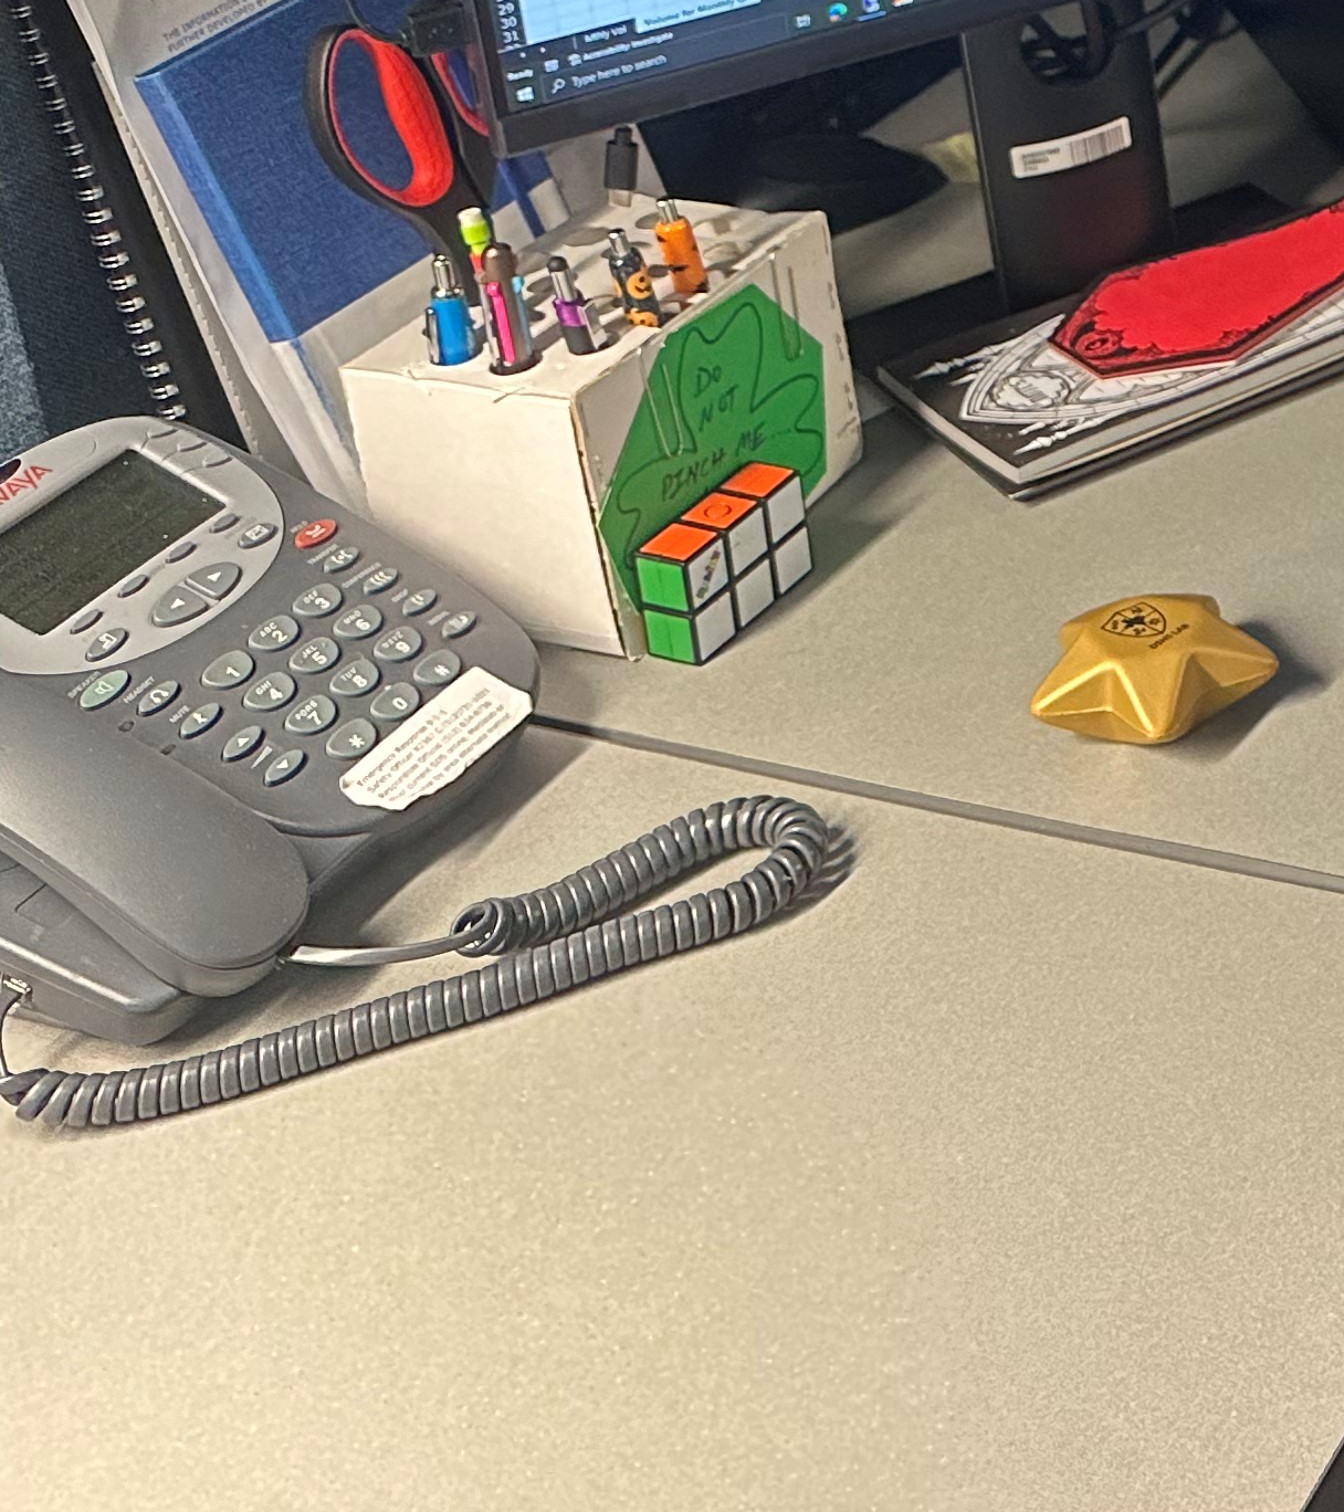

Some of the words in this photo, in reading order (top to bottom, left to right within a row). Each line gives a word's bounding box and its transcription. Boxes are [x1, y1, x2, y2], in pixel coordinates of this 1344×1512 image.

[498, 2, 515, 15] 29
[166, 26, 206, 53] FURTHER
[204, 2, 256, 33] DEVELOPED
[500, 17, 518, 28] 30
[162, 27, 180, 41] THE
[503, 31, 519, 42] 31
[571, 72, 597, 89] Type
[598, 68, 620, 82] here
[621, 62, 636, 74] to
[636, 54, 667, 72] search
[698, 384, 738, 432] NOT
[662, 447, 725, 501] PINCH
[735, 421, 768, 457] ME
[0, 465, 53, 505] VAYA
[314, 596, 330, 609] 3
[260, 622, 278, 638] ABC
[272, 630, 288, 642] 2
[355, 619, 371, 631] 6
[302, 645, 318, 659] JKL
[312, 652, 327, 665] 5
[396, 641, 410, 654] 9
[226, 666, 241, 678] 1
[341, 667, 357, 681] TUV
[355, 674, 368, 688] 8
[123, 676, 156, 705] HEADSET
[256, 681, 271, 695] GHI
[269, 687, 283, 700] 4
[392, 697, 408, 710] 0
[169, 704, 190, 724] MUTE
[307, 712, 321, 725] 7
